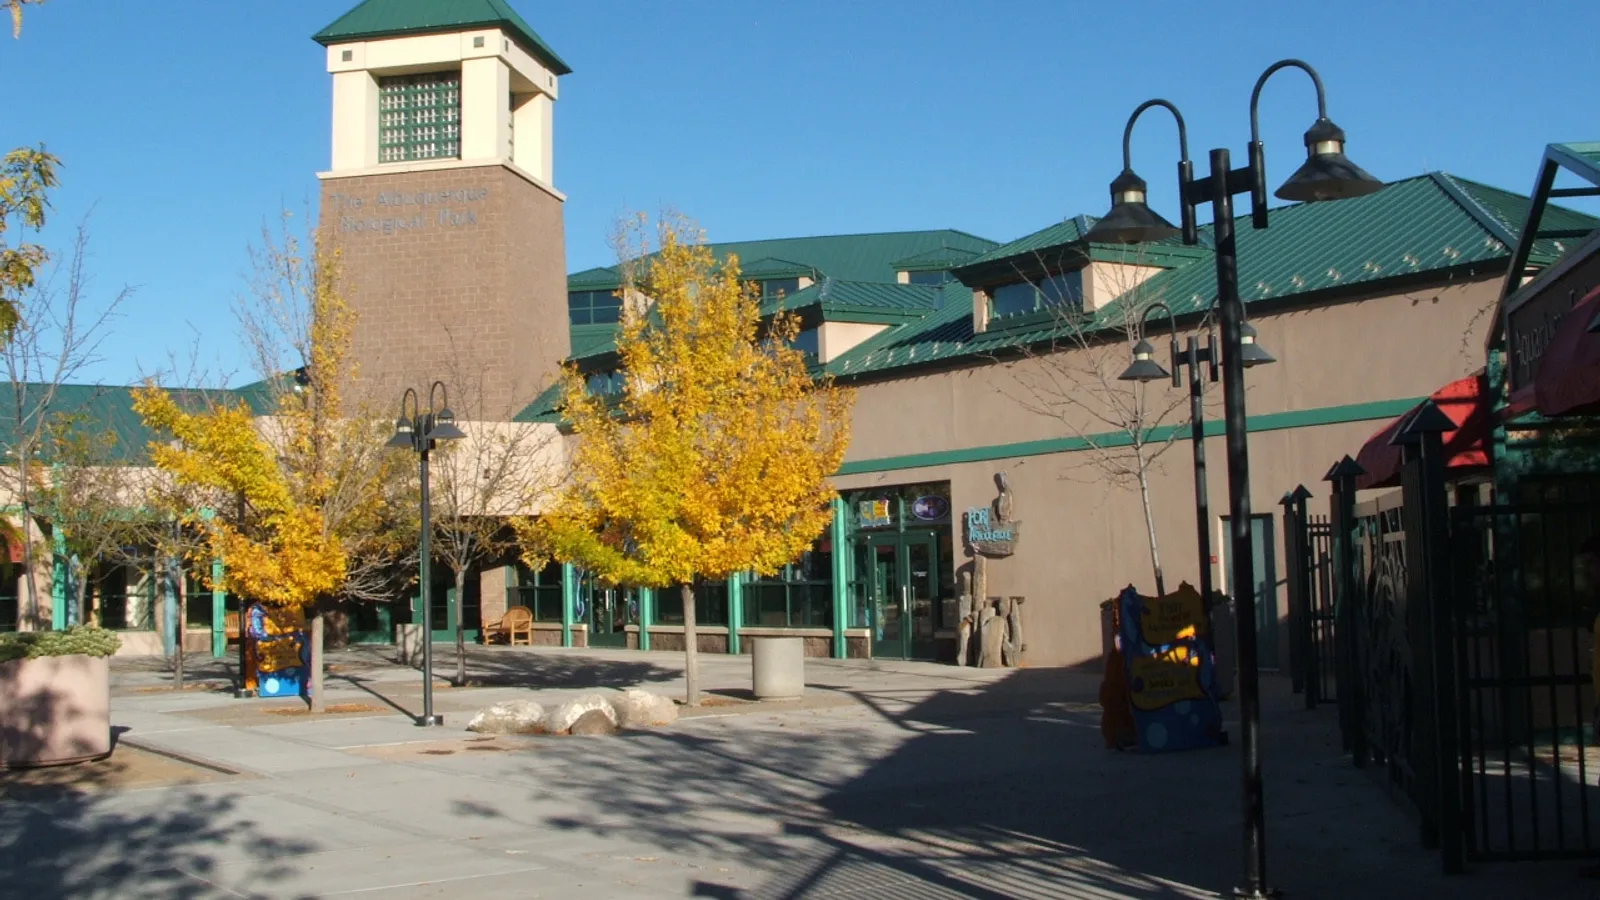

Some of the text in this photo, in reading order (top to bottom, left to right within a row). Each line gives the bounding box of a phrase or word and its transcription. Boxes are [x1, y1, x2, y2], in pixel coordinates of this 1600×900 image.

[329, 187, 488, 211] The Albuquerque
[438, 207, 478, 227] Park
